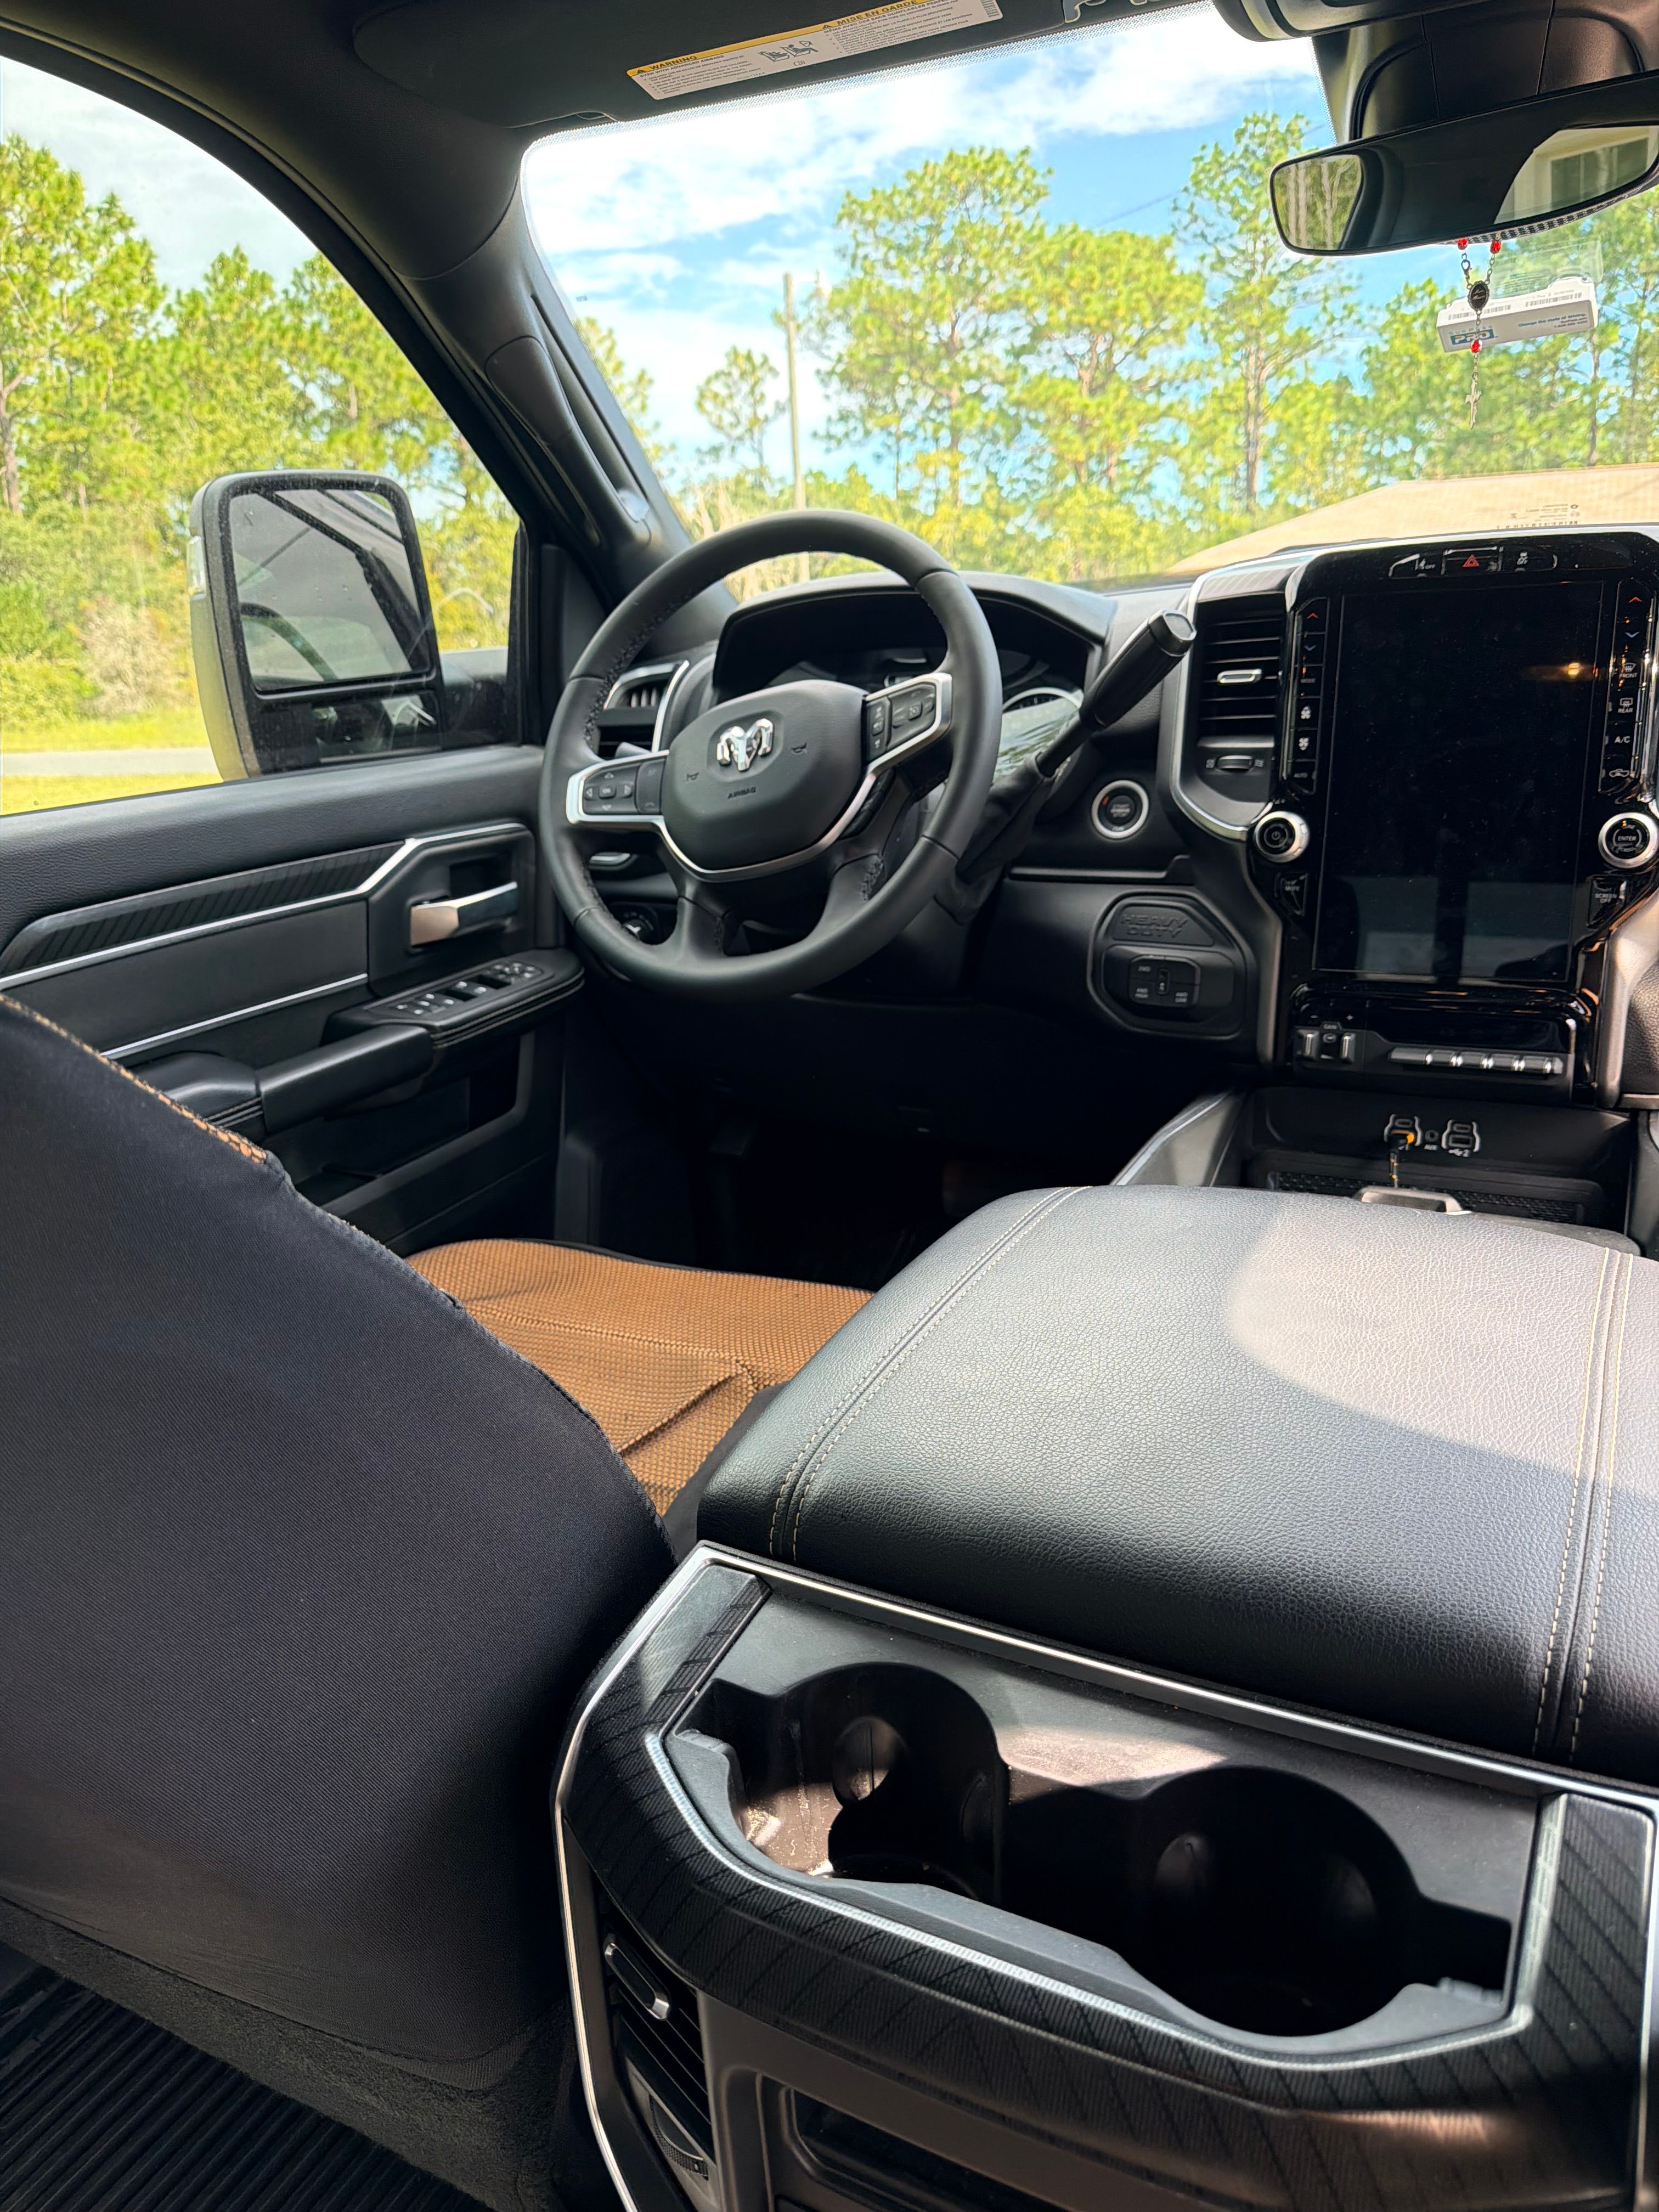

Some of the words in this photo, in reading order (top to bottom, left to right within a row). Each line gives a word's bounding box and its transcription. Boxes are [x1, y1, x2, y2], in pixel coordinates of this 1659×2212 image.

[837, 14, 864, 24] MISE
[882, 0, 917, 12] GARDE
[650, 55, 697, 70] WARNING
[1454, 332, 1490, 343] PRO
[1614, 736, 1630, 744] A/C
[727, 787, 757, 799] AIRBAG
[1121, 915, 1188, 928] HEAVY
[1126, 924, 1182, 938] DUTY
[1463, 1149, 1470, 1158] 2
